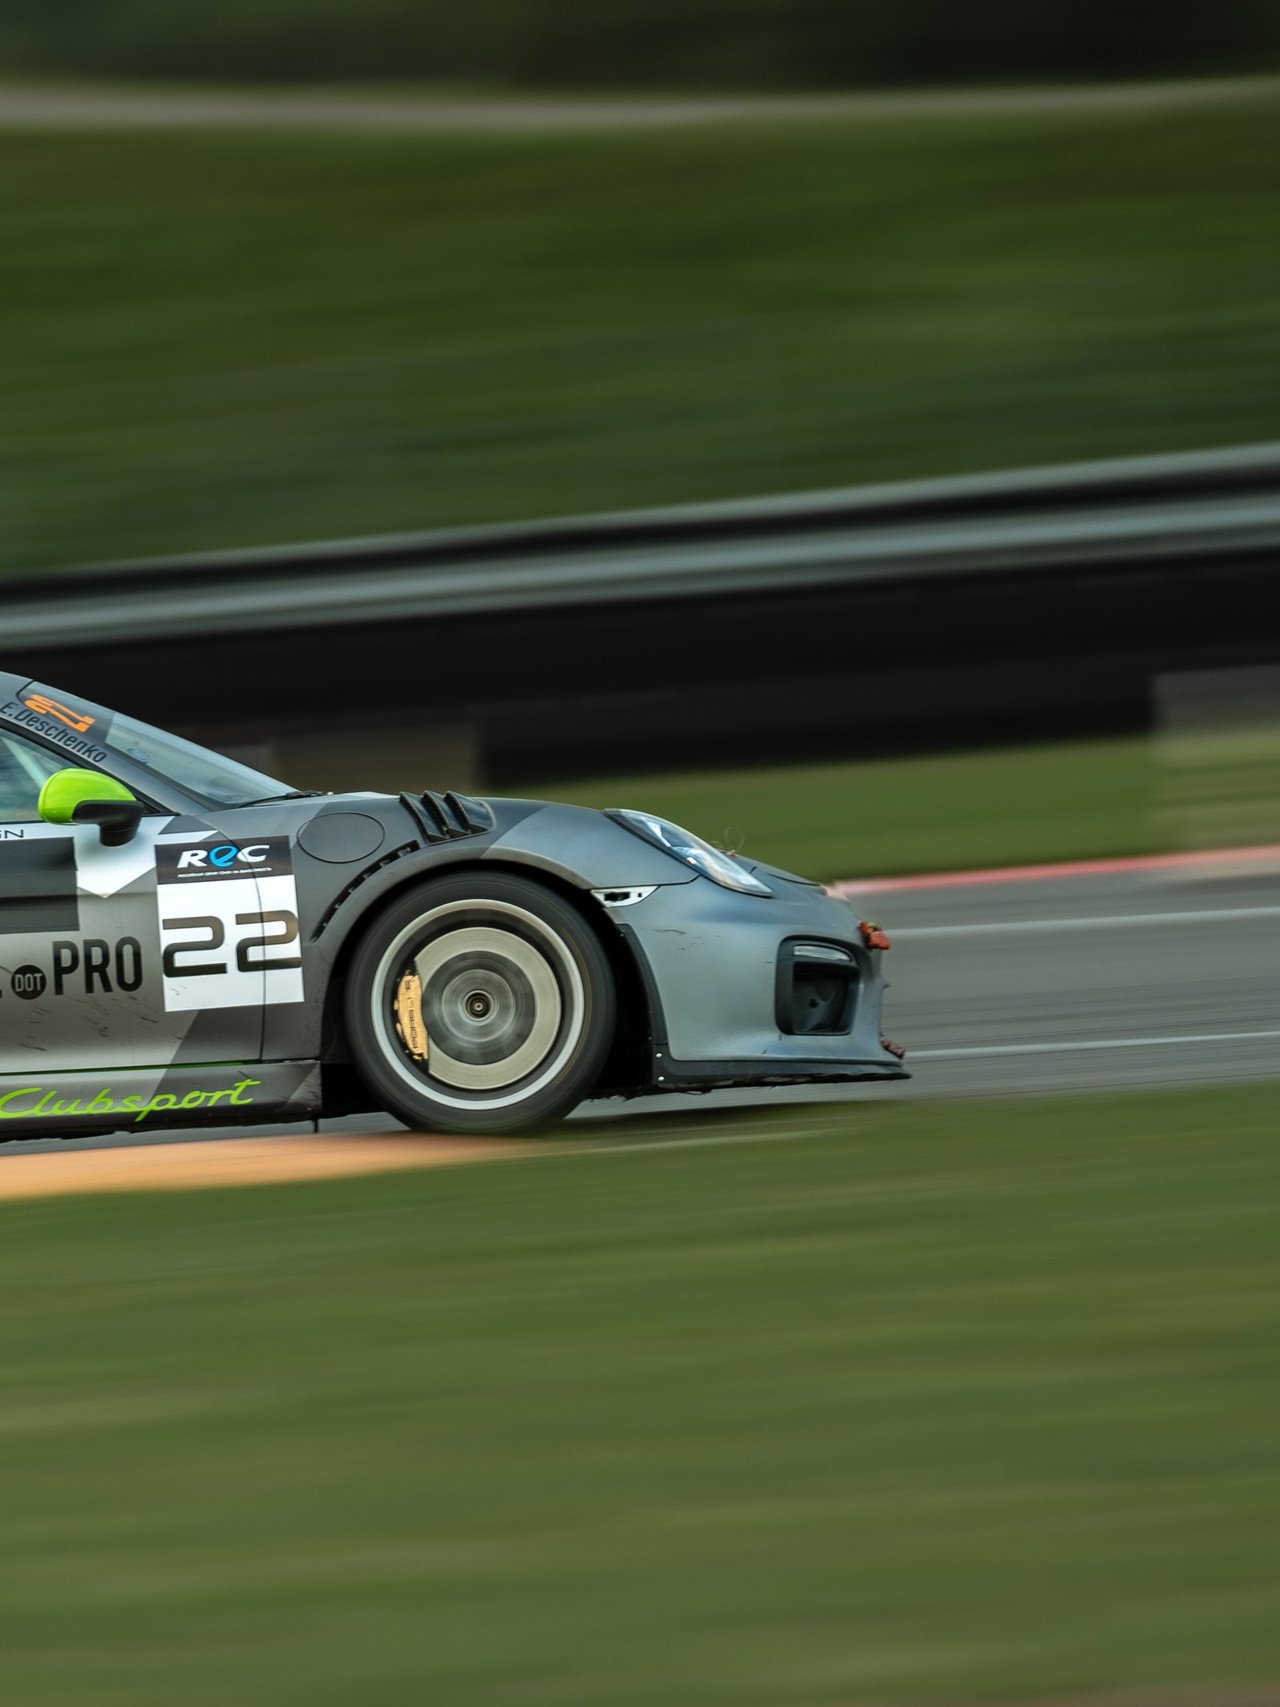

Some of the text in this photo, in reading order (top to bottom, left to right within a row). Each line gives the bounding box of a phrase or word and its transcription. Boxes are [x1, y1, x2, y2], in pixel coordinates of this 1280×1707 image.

[14, 973, 43, 992] DOT
[52, 936, 143, 995] PRO
[162, 909, 302, 978] 22
